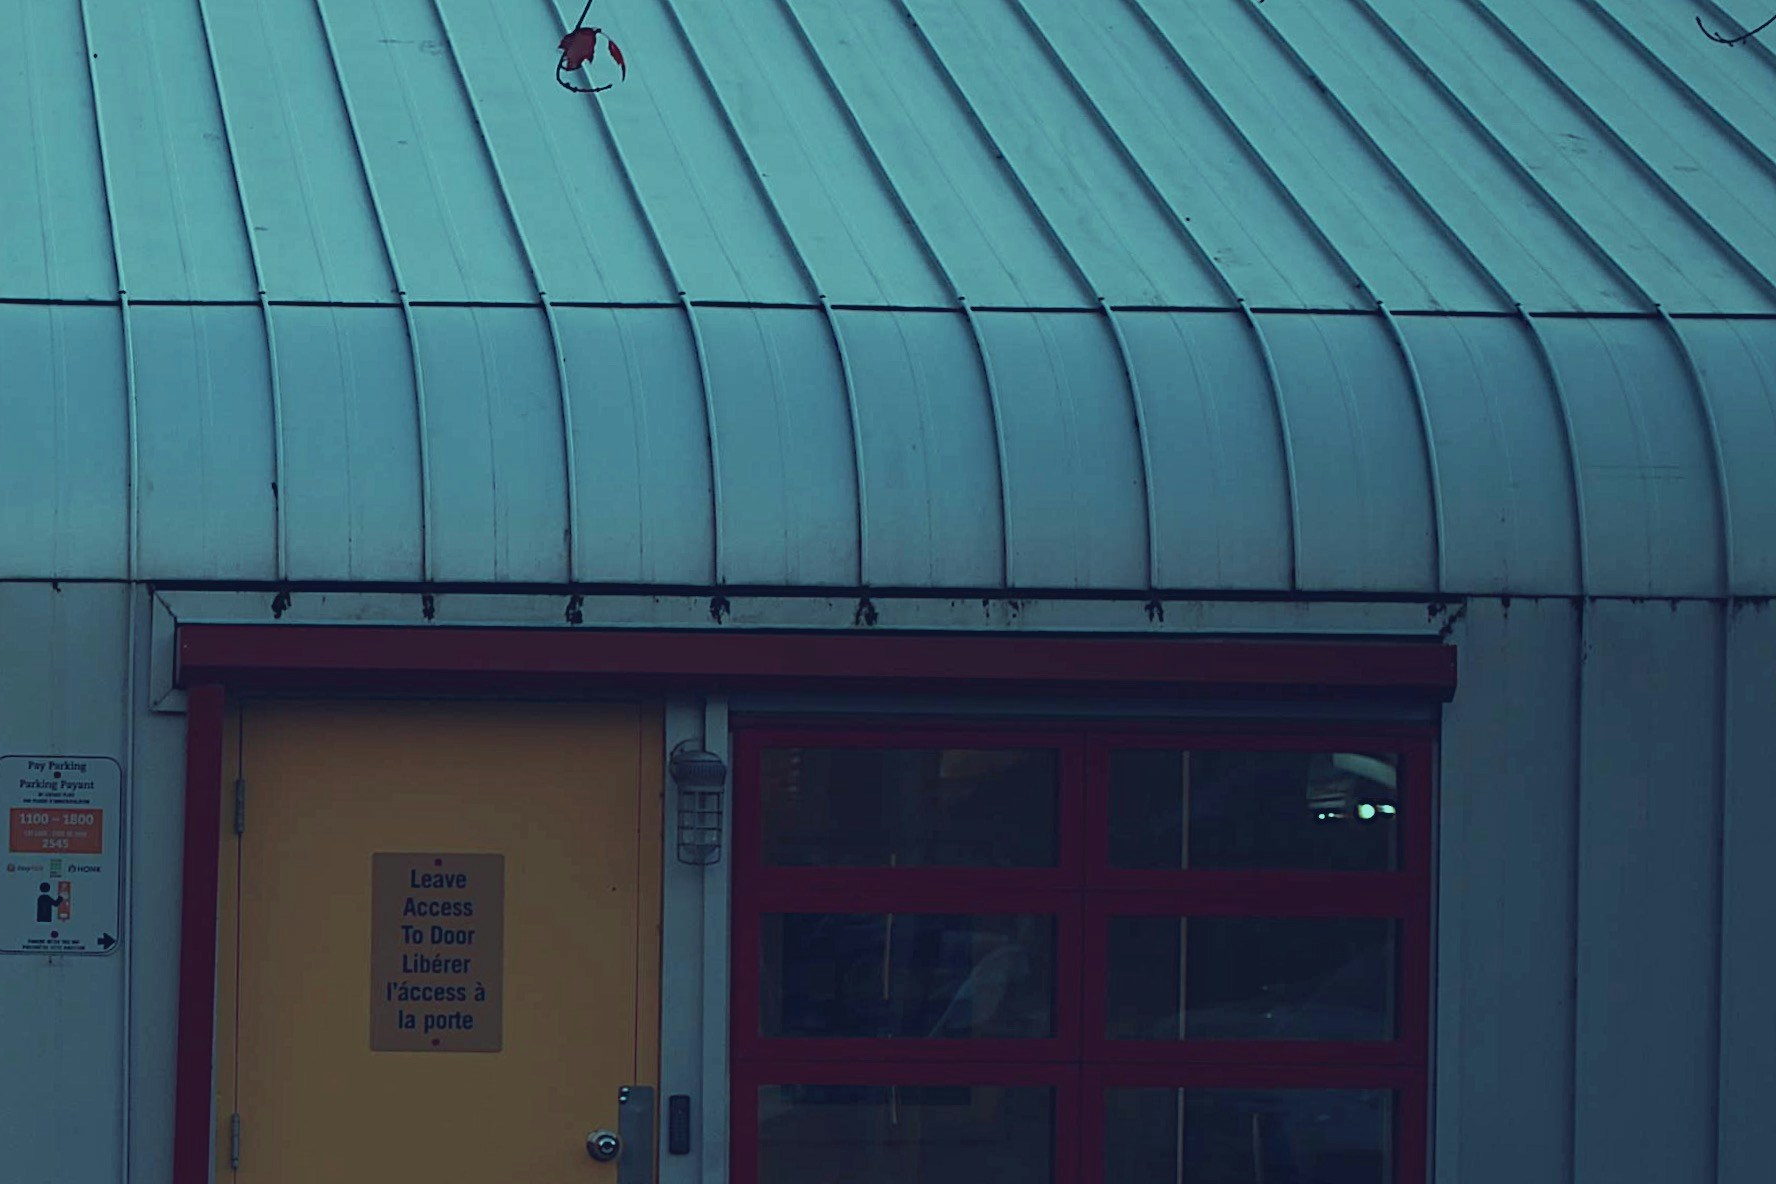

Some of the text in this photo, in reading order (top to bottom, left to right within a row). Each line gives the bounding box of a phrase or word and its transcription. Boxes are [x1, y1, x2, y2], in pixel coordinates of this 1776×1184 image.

[48, 761, 87, 773] Parking
[19, 779, 94, 791] Parking Payant
[410, 869, 467, 889] Leave
[403, 897, 473, 917] Access
[401, 925, 475, 945] To Door
[402, 952, 471, 974] Libérer
[474, 981, 486, 1002] à
[398, 1010, 474, 1034] la porte
